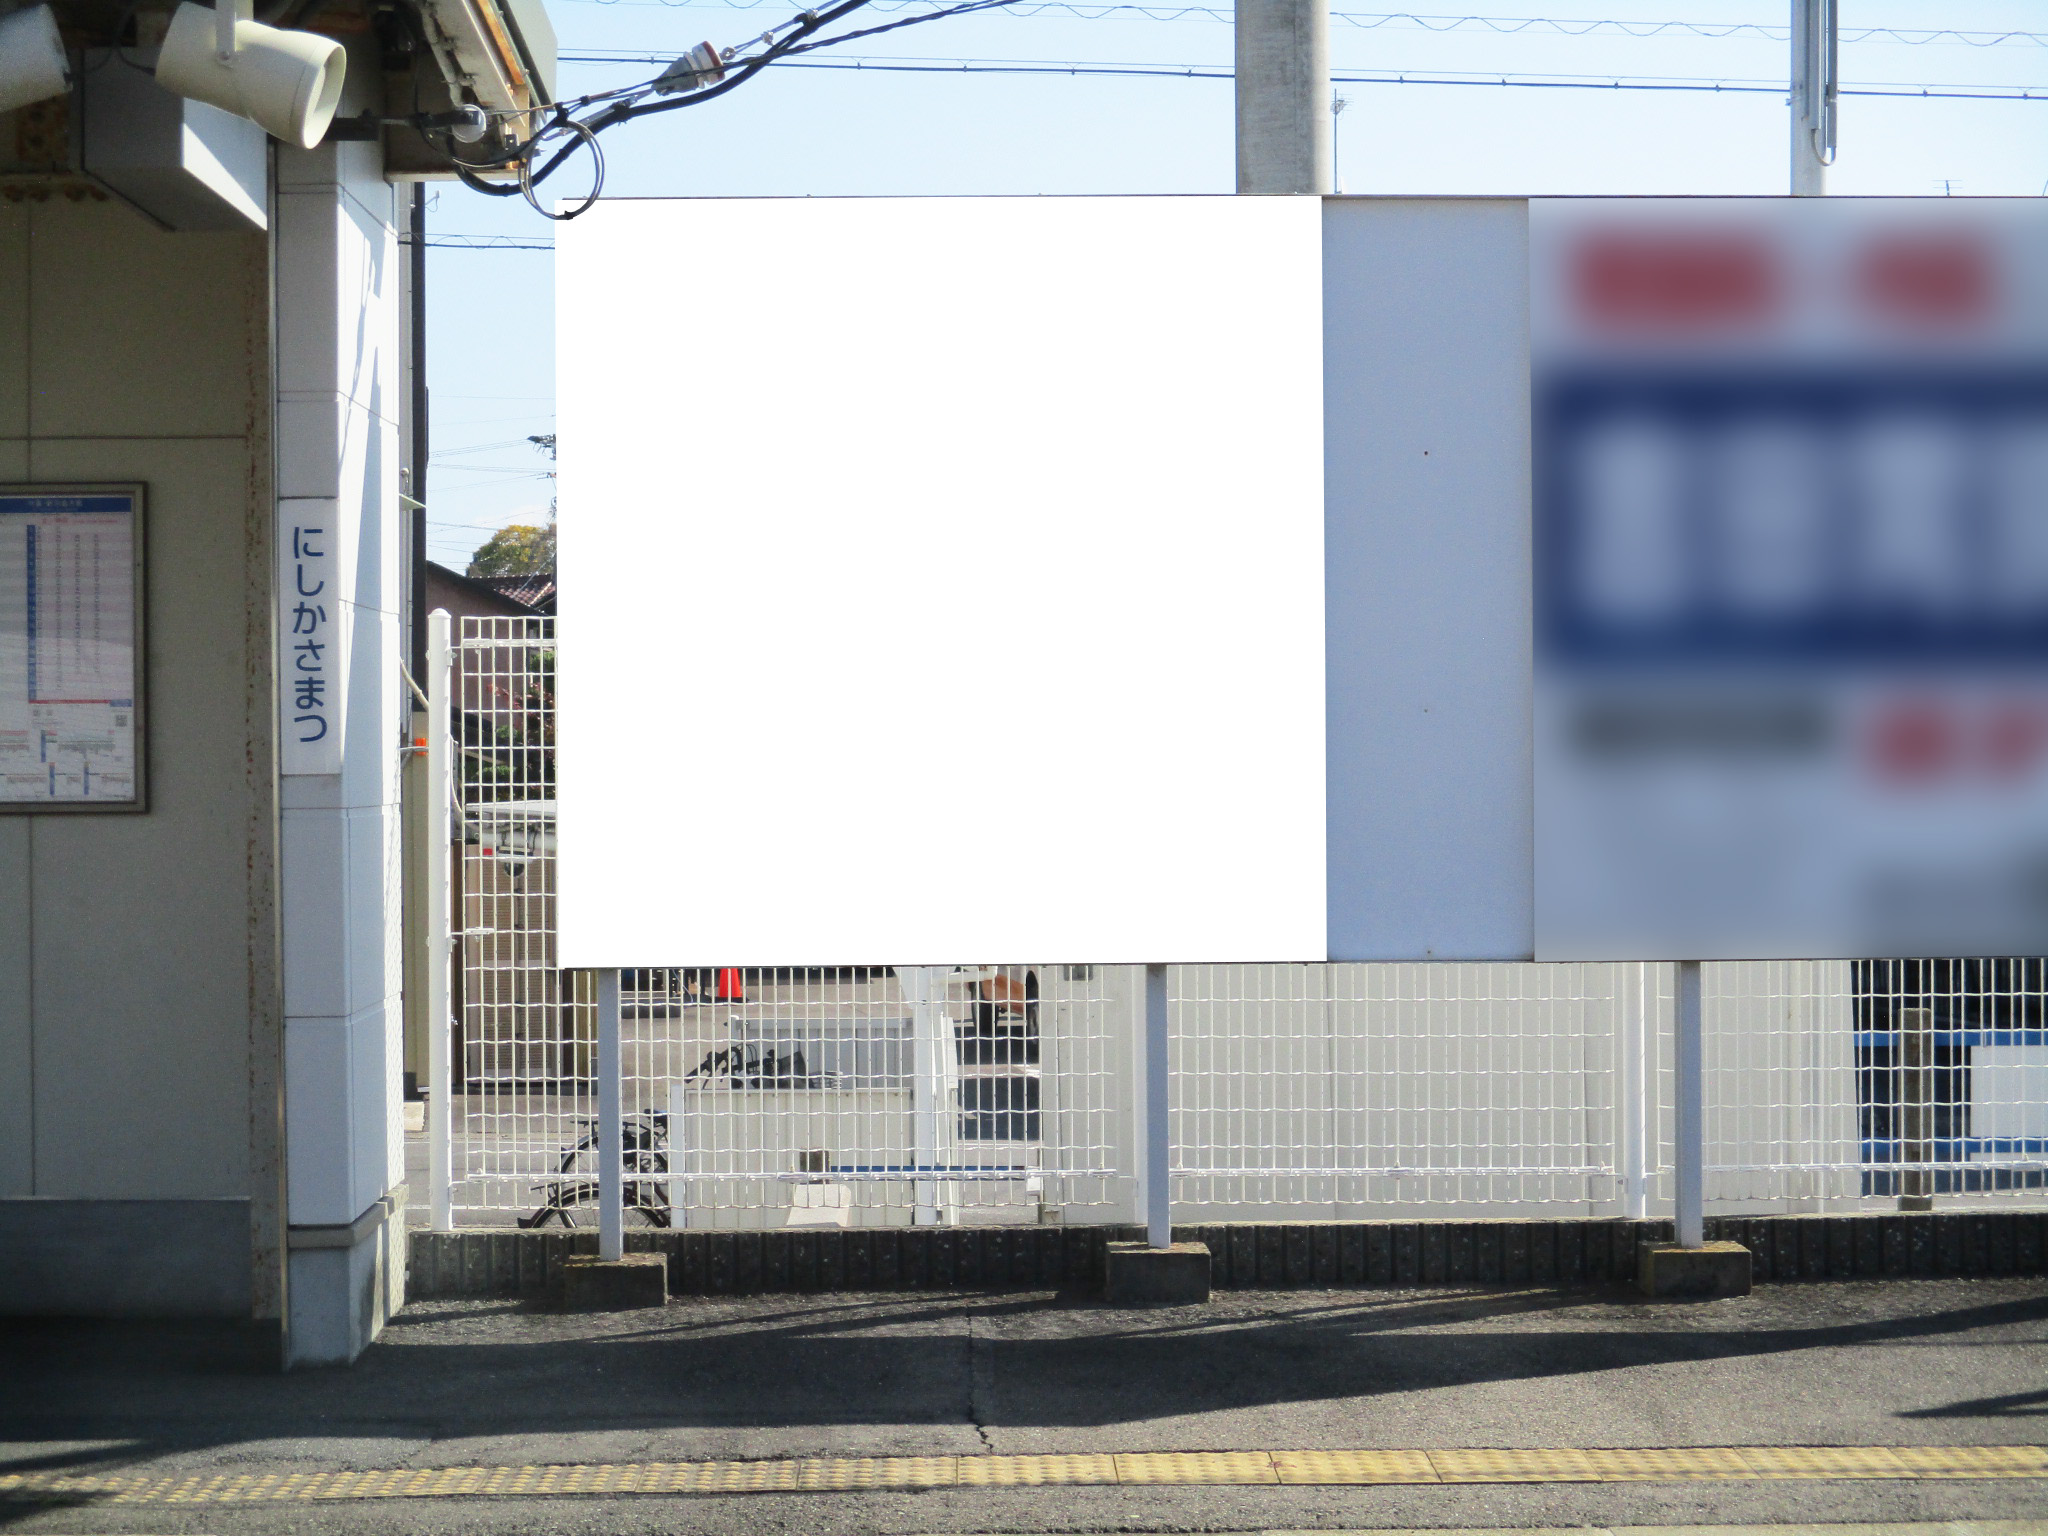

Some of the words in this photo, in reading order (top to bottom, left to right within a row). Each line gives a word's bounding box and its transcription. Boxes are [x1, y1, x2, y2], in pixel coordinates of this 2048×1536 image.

[292, 526, 328, 743] にしかさまつ
